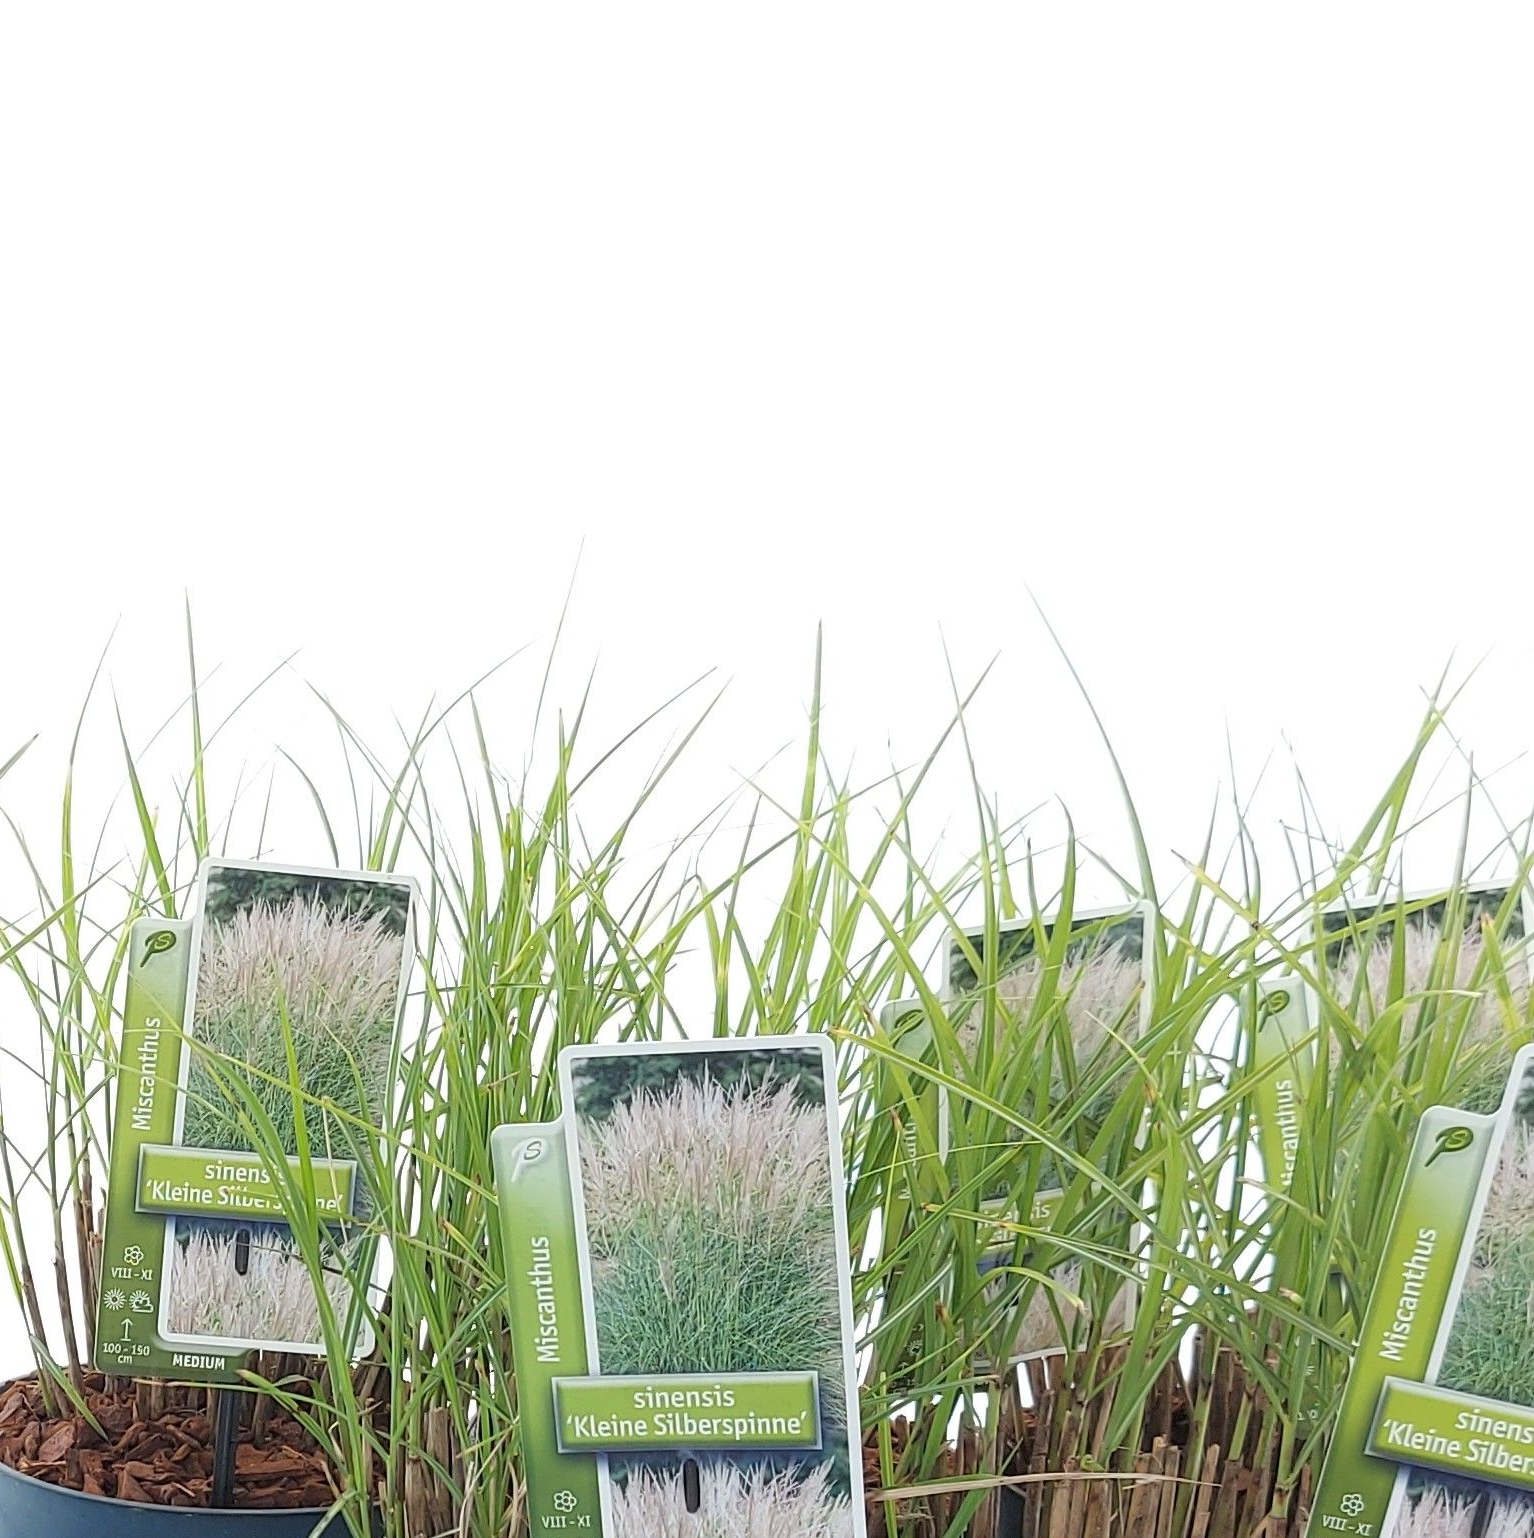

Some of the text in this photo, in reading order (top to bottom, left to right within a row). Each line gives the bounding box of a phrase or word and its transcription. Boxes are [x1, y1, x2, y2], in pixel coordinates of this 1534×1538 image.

[131, 1017, 161, 1131] Miscanthus
[111, 1267, 132, 1279] VIII
[141, 1269, 153, 1281] XI
[536, 1235, 561, 1366] Miscanthus
[1377, 1226, 1437, 1363] Miscanthus
[102, 1343, 121, 1354] 100
[132, 1346, 150, 1356] 150
[117, 1355, 133, 1364] cm
[172, 1353, 226, 1371] MEDIUM
[633, 1383, 736, 1410] sinensis
[541, 1515, 567, 1528] VIII
[577, 1514, 591, 1528] XI
[1322, 1514, 1347, 1531] VIII
[1355, 1522, 1373, 1537] XI
